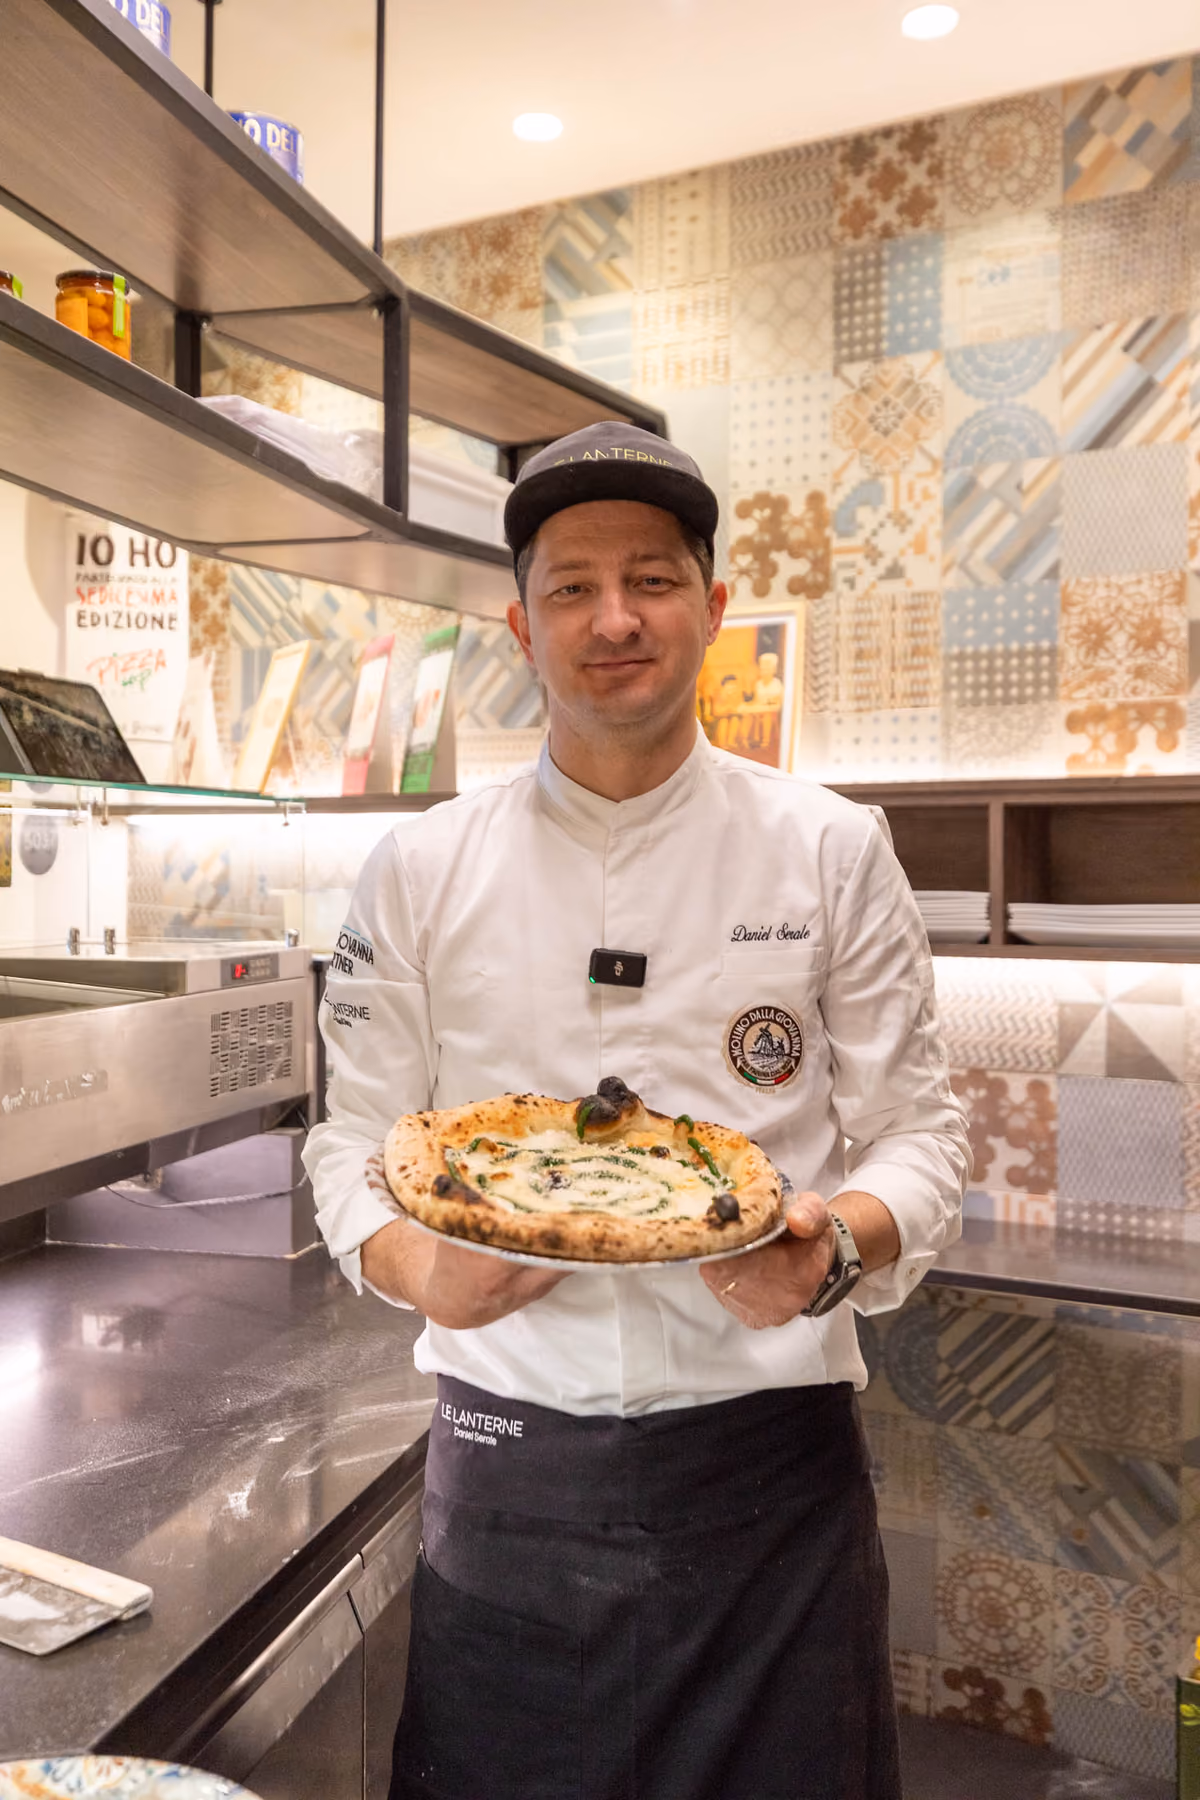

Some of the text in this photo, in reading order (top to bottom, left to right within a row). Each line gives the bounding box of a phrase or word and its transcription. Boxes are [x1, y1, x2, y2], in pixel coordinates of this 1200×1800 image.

[76, 533, 178, 569] IO HO
[76, 610, 178, 631] EDIZIONE
[730, 924, 772, 942] Daniel
[731, 1008, 801, 1057] MOLINO DALLA GIOVANNA
[441, 1402, 524, 1438] LE LANTERNE
